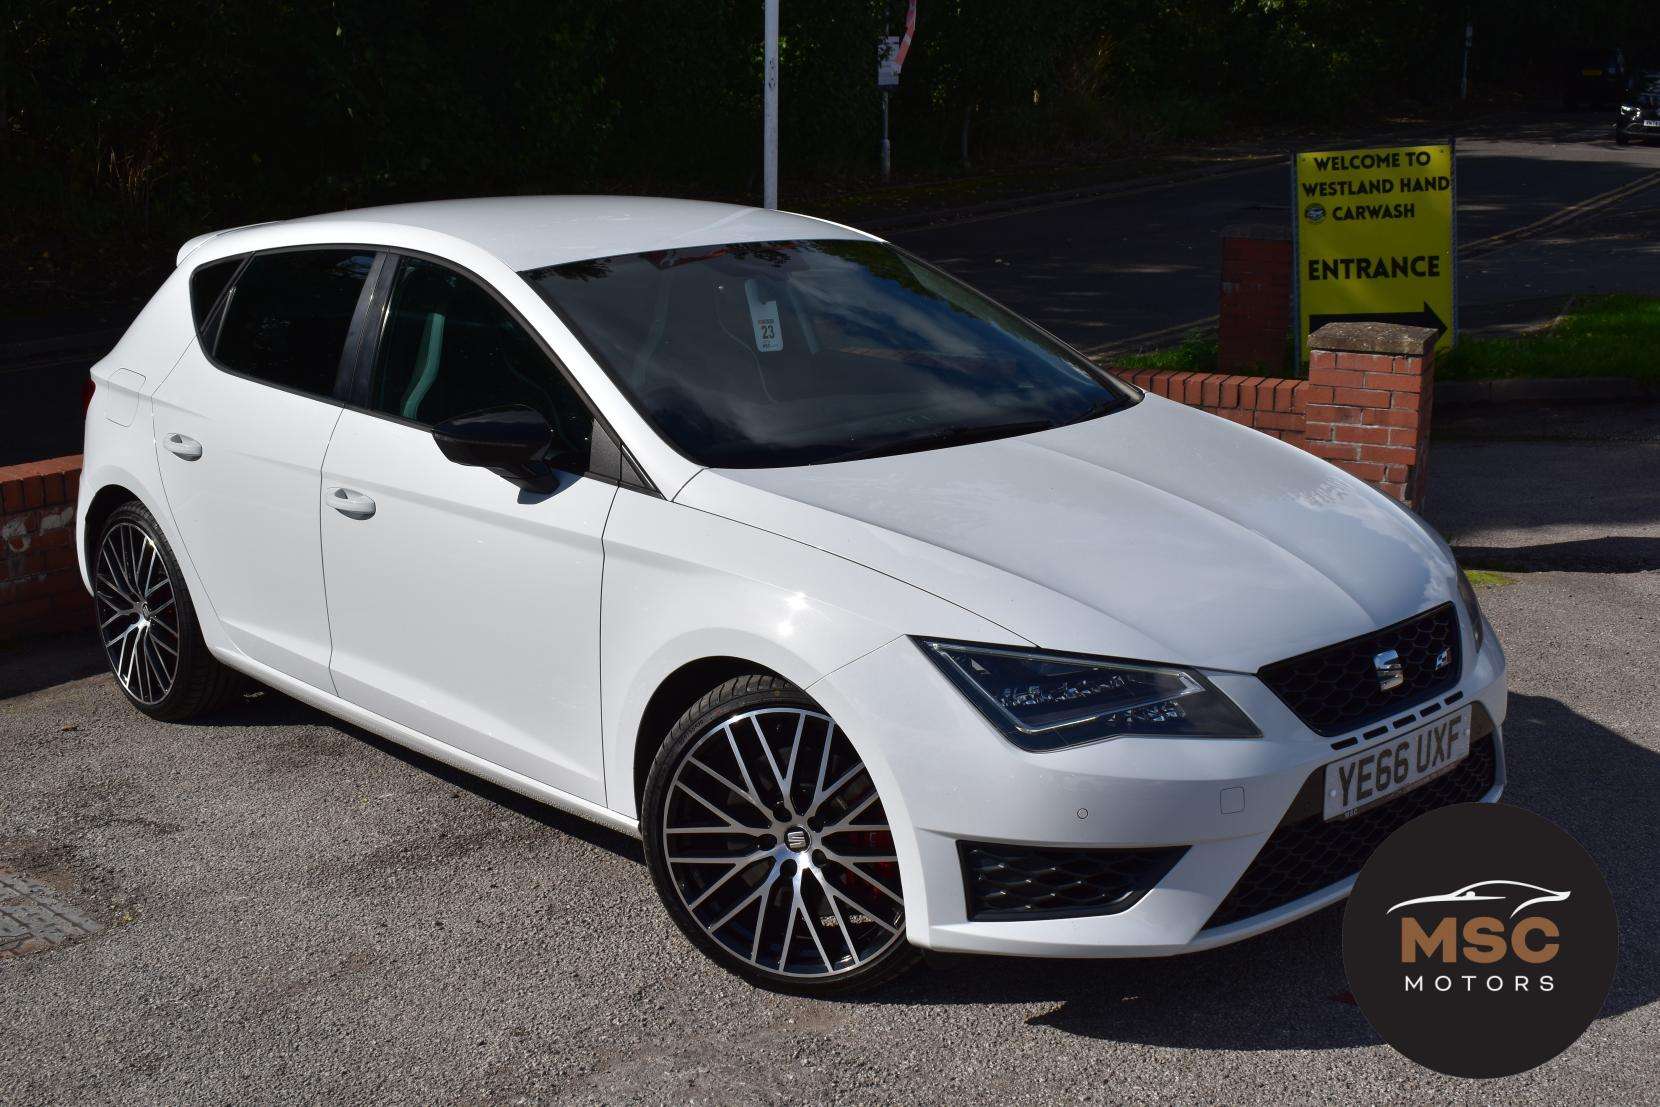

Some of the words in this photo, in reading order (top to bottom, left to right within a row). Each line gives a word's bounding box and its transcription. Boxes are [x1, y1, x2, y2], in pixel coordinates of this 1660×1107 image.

[1314, 153, 1400, 171] WELCOME
[1405, 152, 1431, 167] TO
[1302, 179, 1394, 197] WESTLAND
[1400, 176, 1450, 193] HAND
[1332, 203, 1416, 221] CARWASH
[1308, 255, 1441, 281] ENTRANCE
[761, 325, 775, 339] 23
[1338, 740, 1410, 807] YE66
[1416, 714, 1462, 774] UXF
